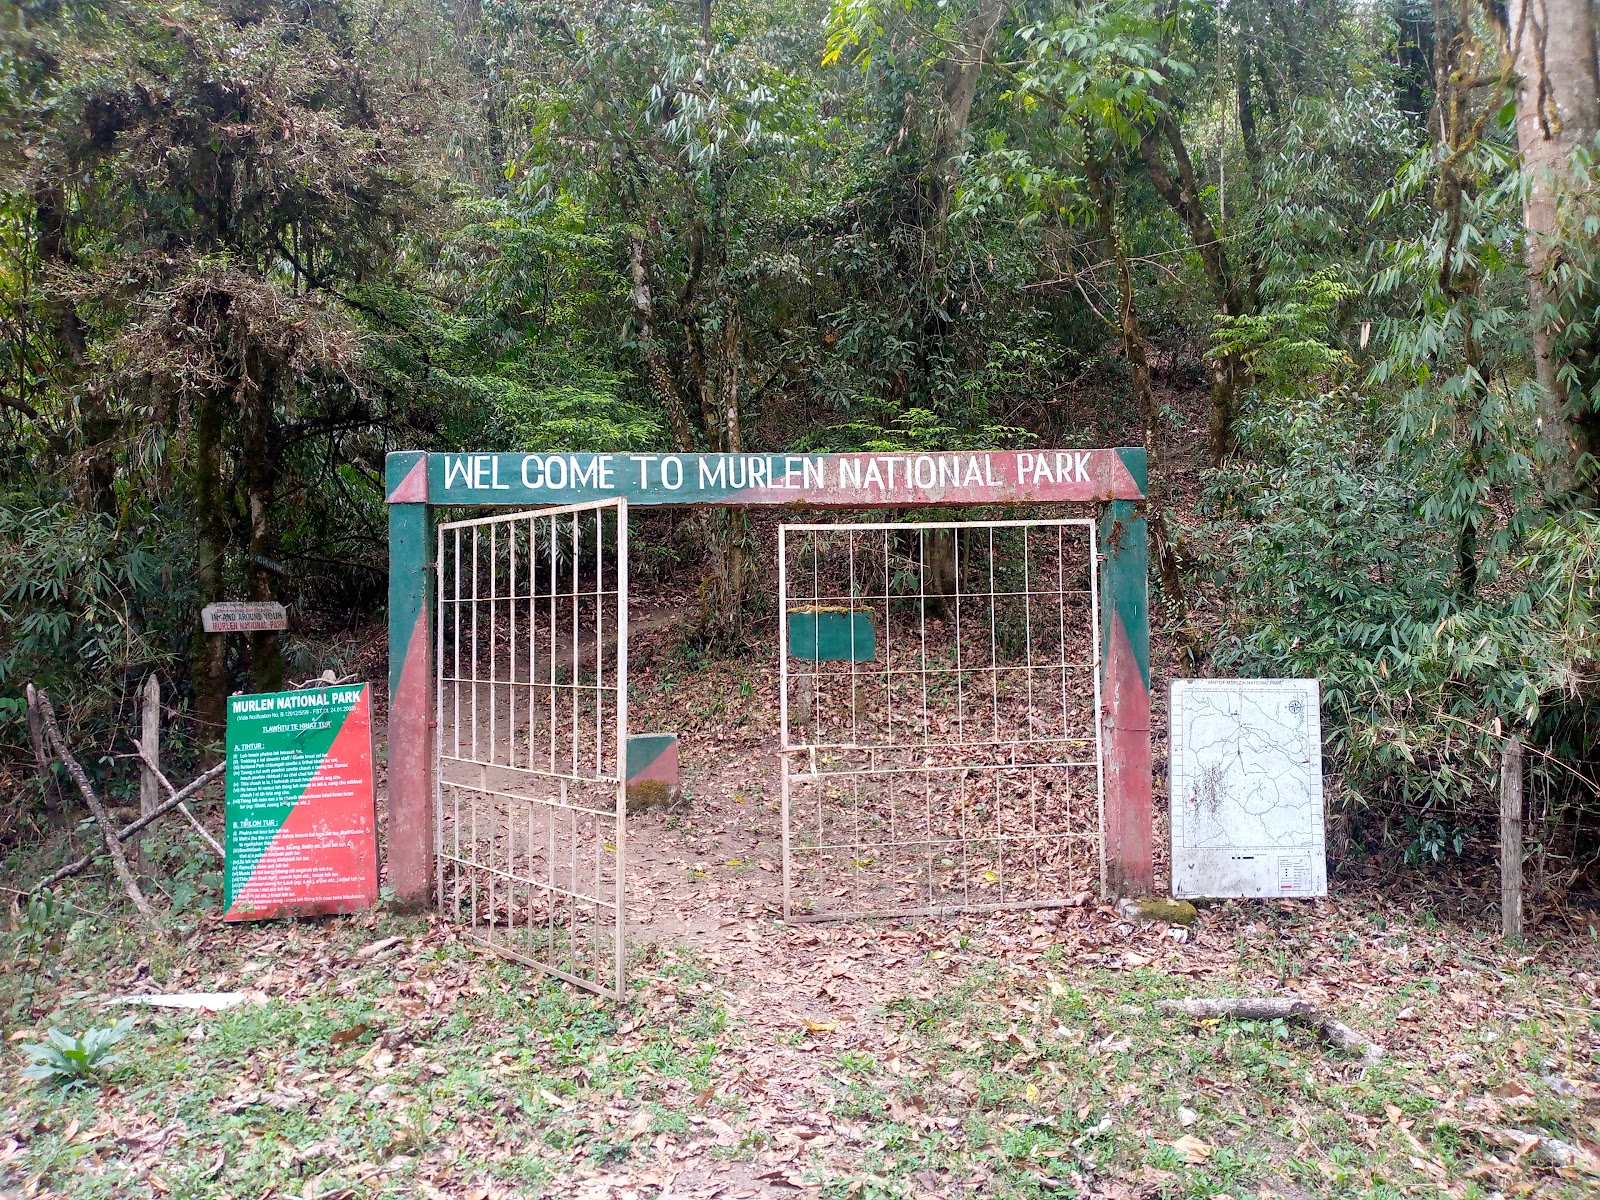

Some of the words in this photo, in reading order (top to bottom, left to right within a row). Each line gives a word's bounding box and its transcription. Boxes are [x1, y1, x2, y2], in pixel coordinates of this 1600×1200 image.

[444, 456, 509, 490] WEL
[521, 456, 614, 489] COME
[630, 456, 684, 490] TO
[699, 456, 824, 490] MURLEN
[840, 454, 1002, 490] NATIONAL
[1017, 452, 1092, 485] PARK
[238, 612, 262, 620] AROUND
[212, 622, 238, 630] MURLEN
[233, 699, 274, 713] MURLEN
[277, 694, 329, 710] NATIONAL
[332, 691, 360, 704] PARK
[291, 722, 298, 731] TE
